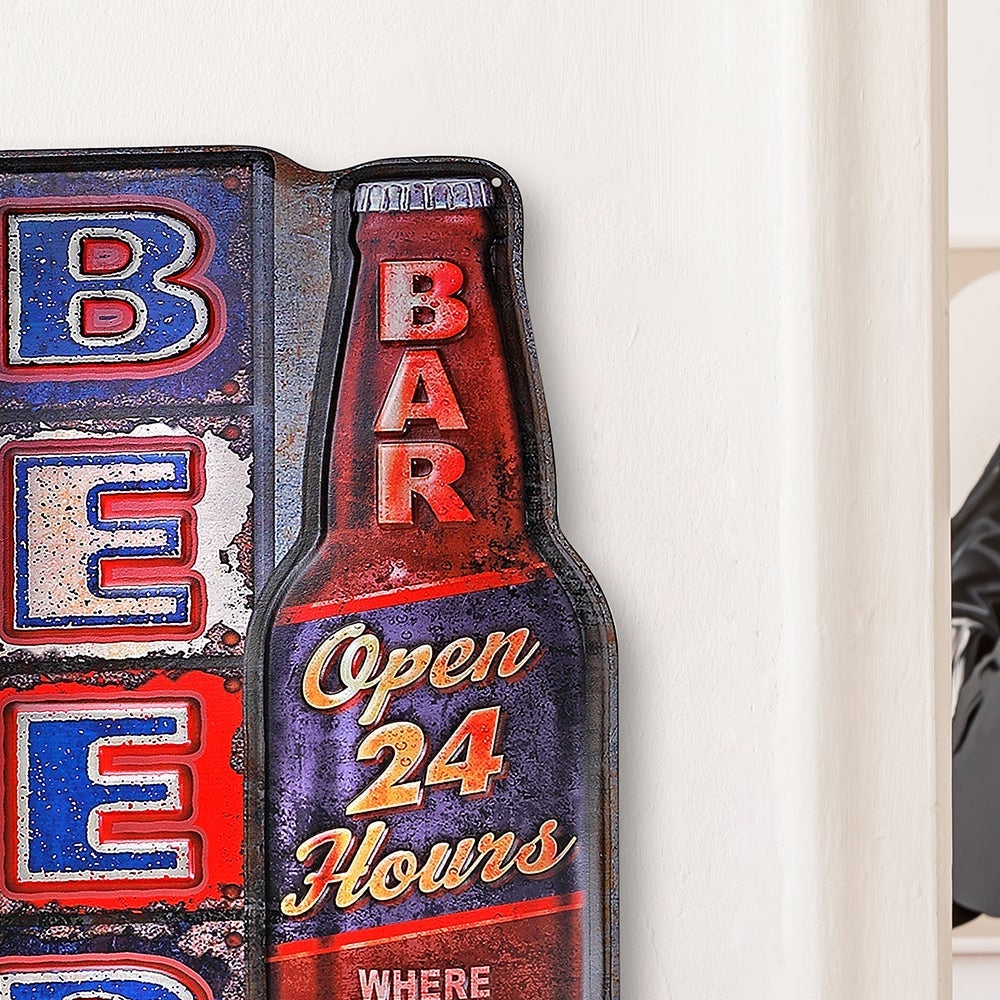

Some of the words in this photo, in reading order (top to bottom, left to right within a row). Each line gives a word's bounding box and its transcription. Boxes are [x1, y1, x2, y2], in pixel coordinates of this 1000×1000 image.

[373, 258, 476, 526] BAR
[302, 622, 540, 725] Open
[344, 704, 505, 817] 24
[279, 818, 578, 919] Hours
